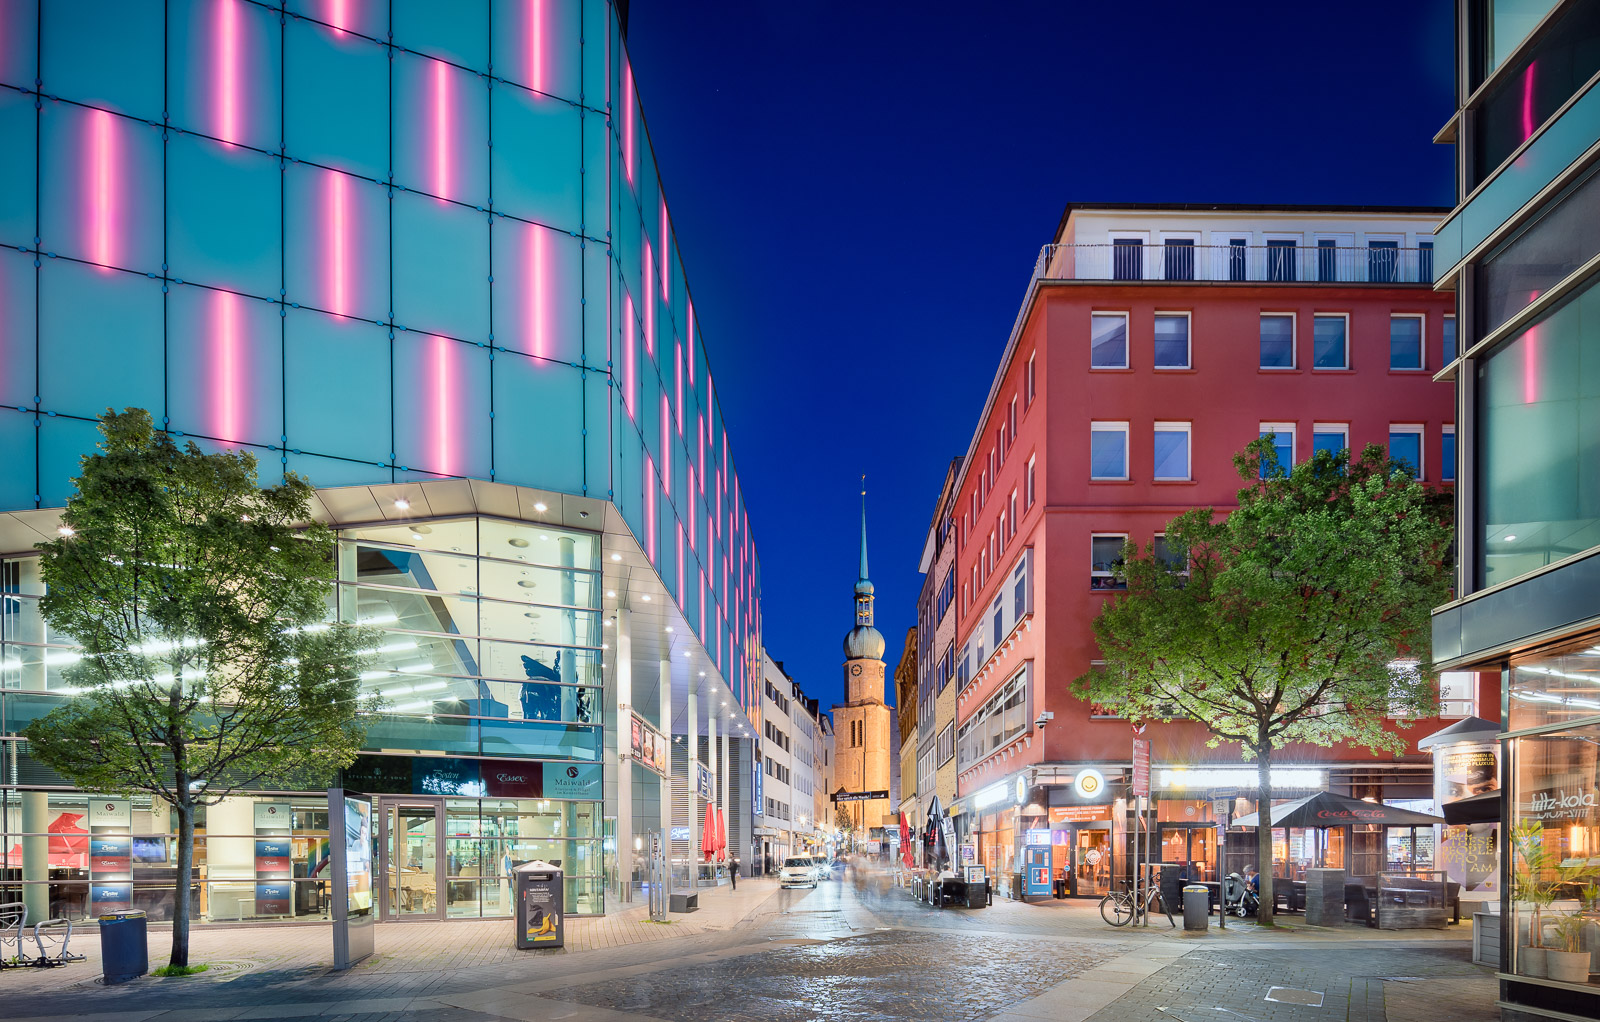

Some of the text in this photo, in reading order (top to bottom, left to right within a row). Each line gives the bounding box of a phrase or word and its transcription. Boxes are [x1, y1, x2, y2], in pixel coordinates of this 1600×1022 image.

[496, 773, 525, 782] Essex
[555, 778, 590, 786] Maiwald
[1317, 809, 1386, 819] Coca-Cola
[1442, 828, 1473, 838] TELL
[1450, 836, 1493, 848] THESE
[1442, 845, 1493, 857] PEOPLE
[1444, 854, 1478, 864] WHO
[1470, 863, 1493, 873] AM
